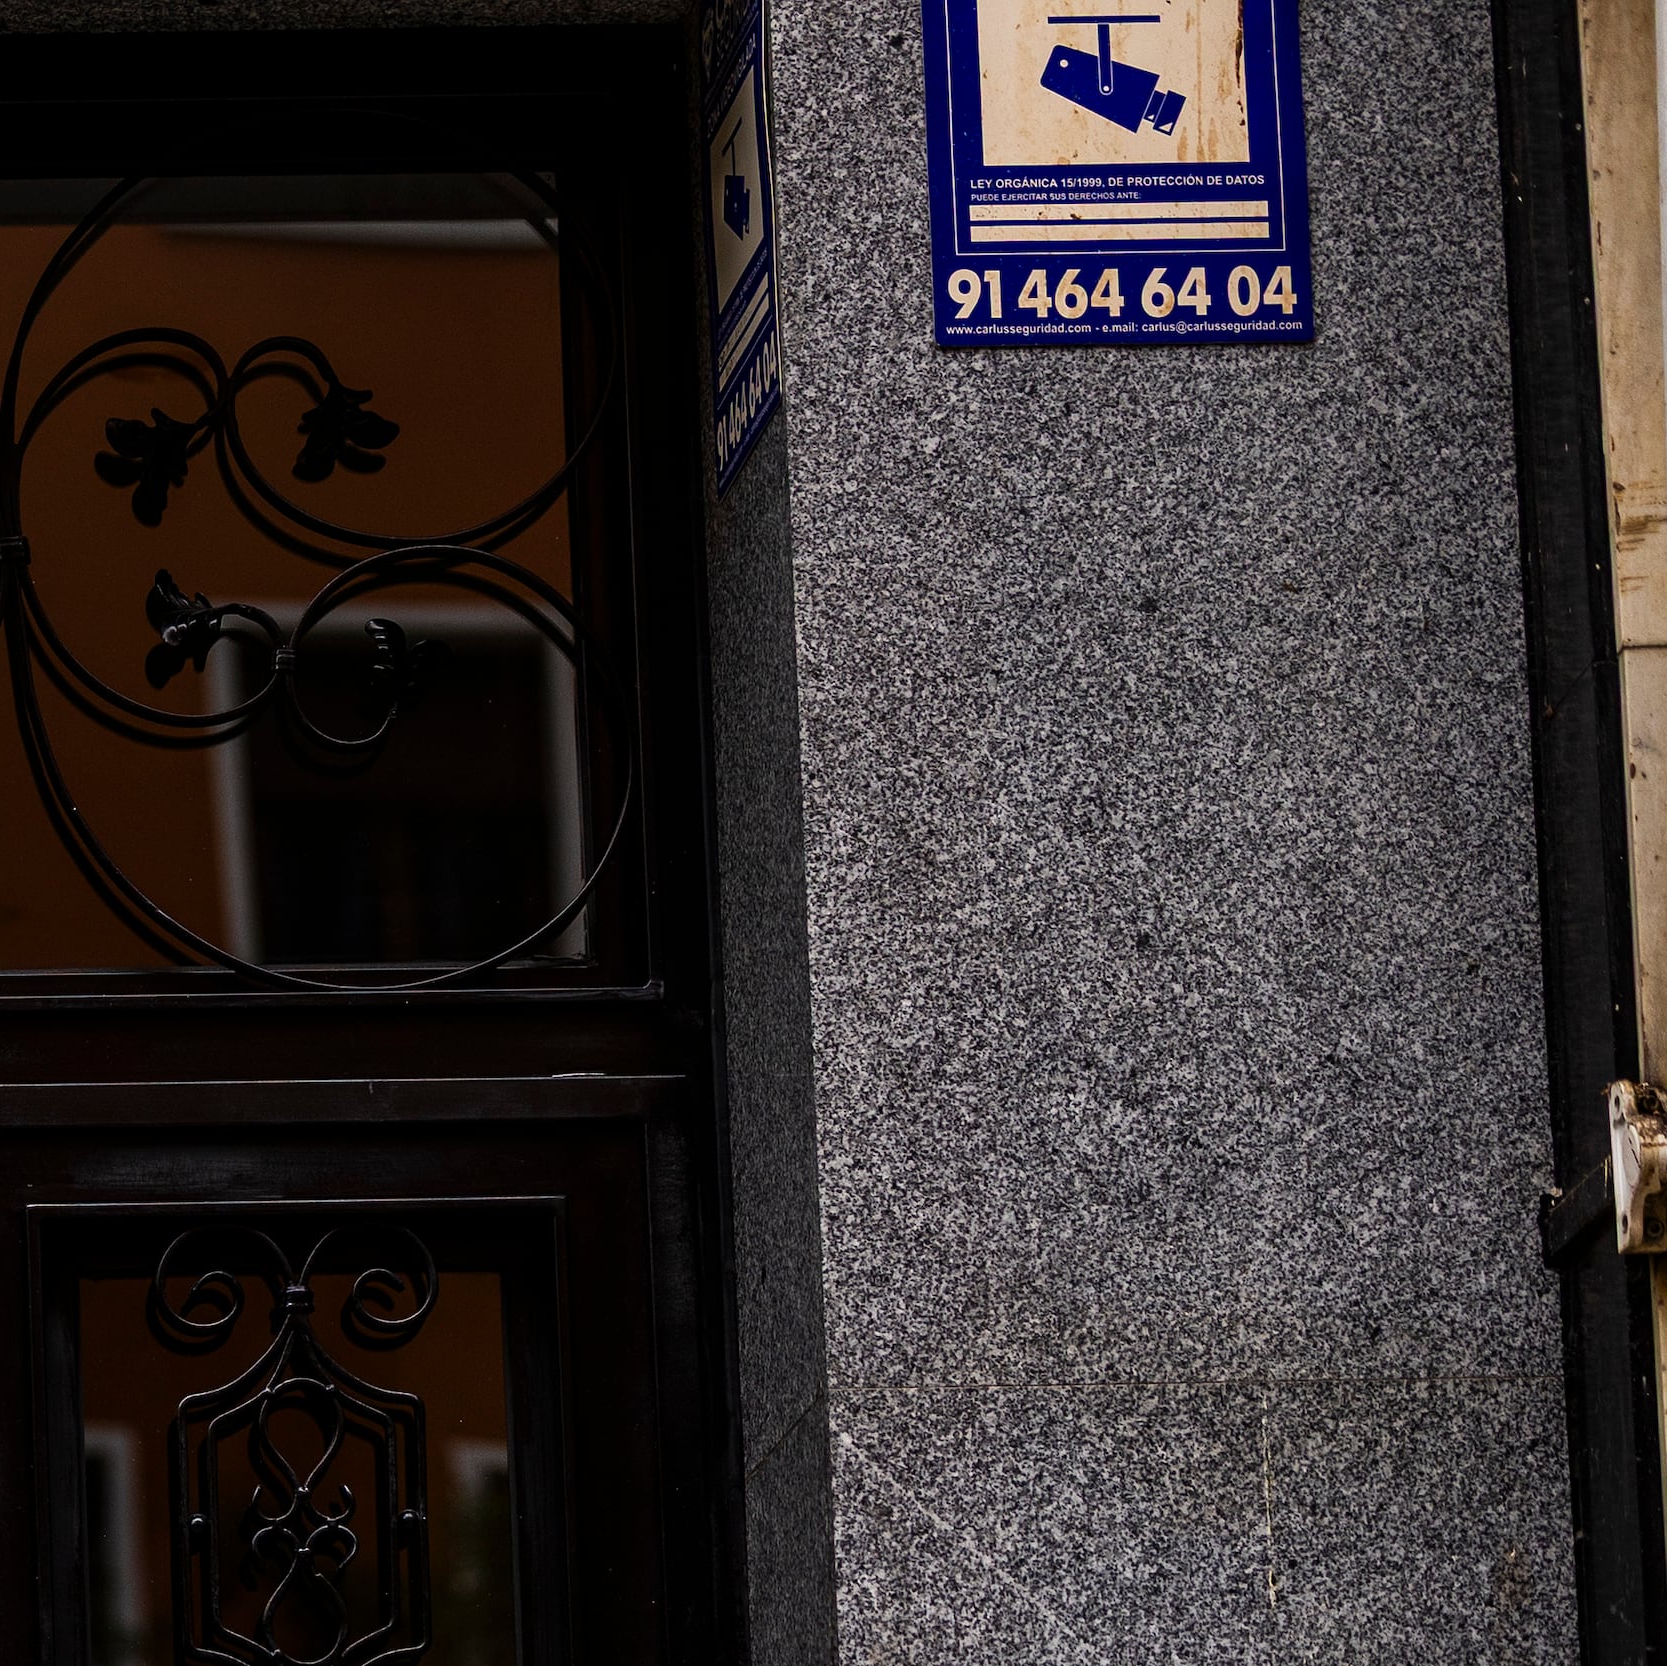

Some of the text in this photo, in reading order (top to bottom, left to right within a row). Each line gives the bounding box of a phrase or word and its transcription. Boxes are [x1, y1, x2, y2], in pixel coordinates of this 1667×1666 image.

[970, 179, 993, 189] LEY
[995, 176, 1058, 189] ORGÁNICA
[1108, 177, 1124, 187] DE
[1127, 174, 1203, 187] PROTECCIÓN
[1207, 175, 1223, 186] DE
[1226, 174, 1265, 185] DATOS
[971, 193, 1000, 202] PUEDE
[1002, 192, 1047, 201] EJERCITAR
[1050, 192, 1066, 201] SUS
[1068, 191, 1115, 200] DERECHOS
[947, 264, 1299, 320] 91 464 64 04
[946, 322, 1092, 336] www.carlusseguridad.com
[1102, 322, 1139, 333] e.mail:
[1141, 320, 1303, 335] carlus@carlusseguridad.com
